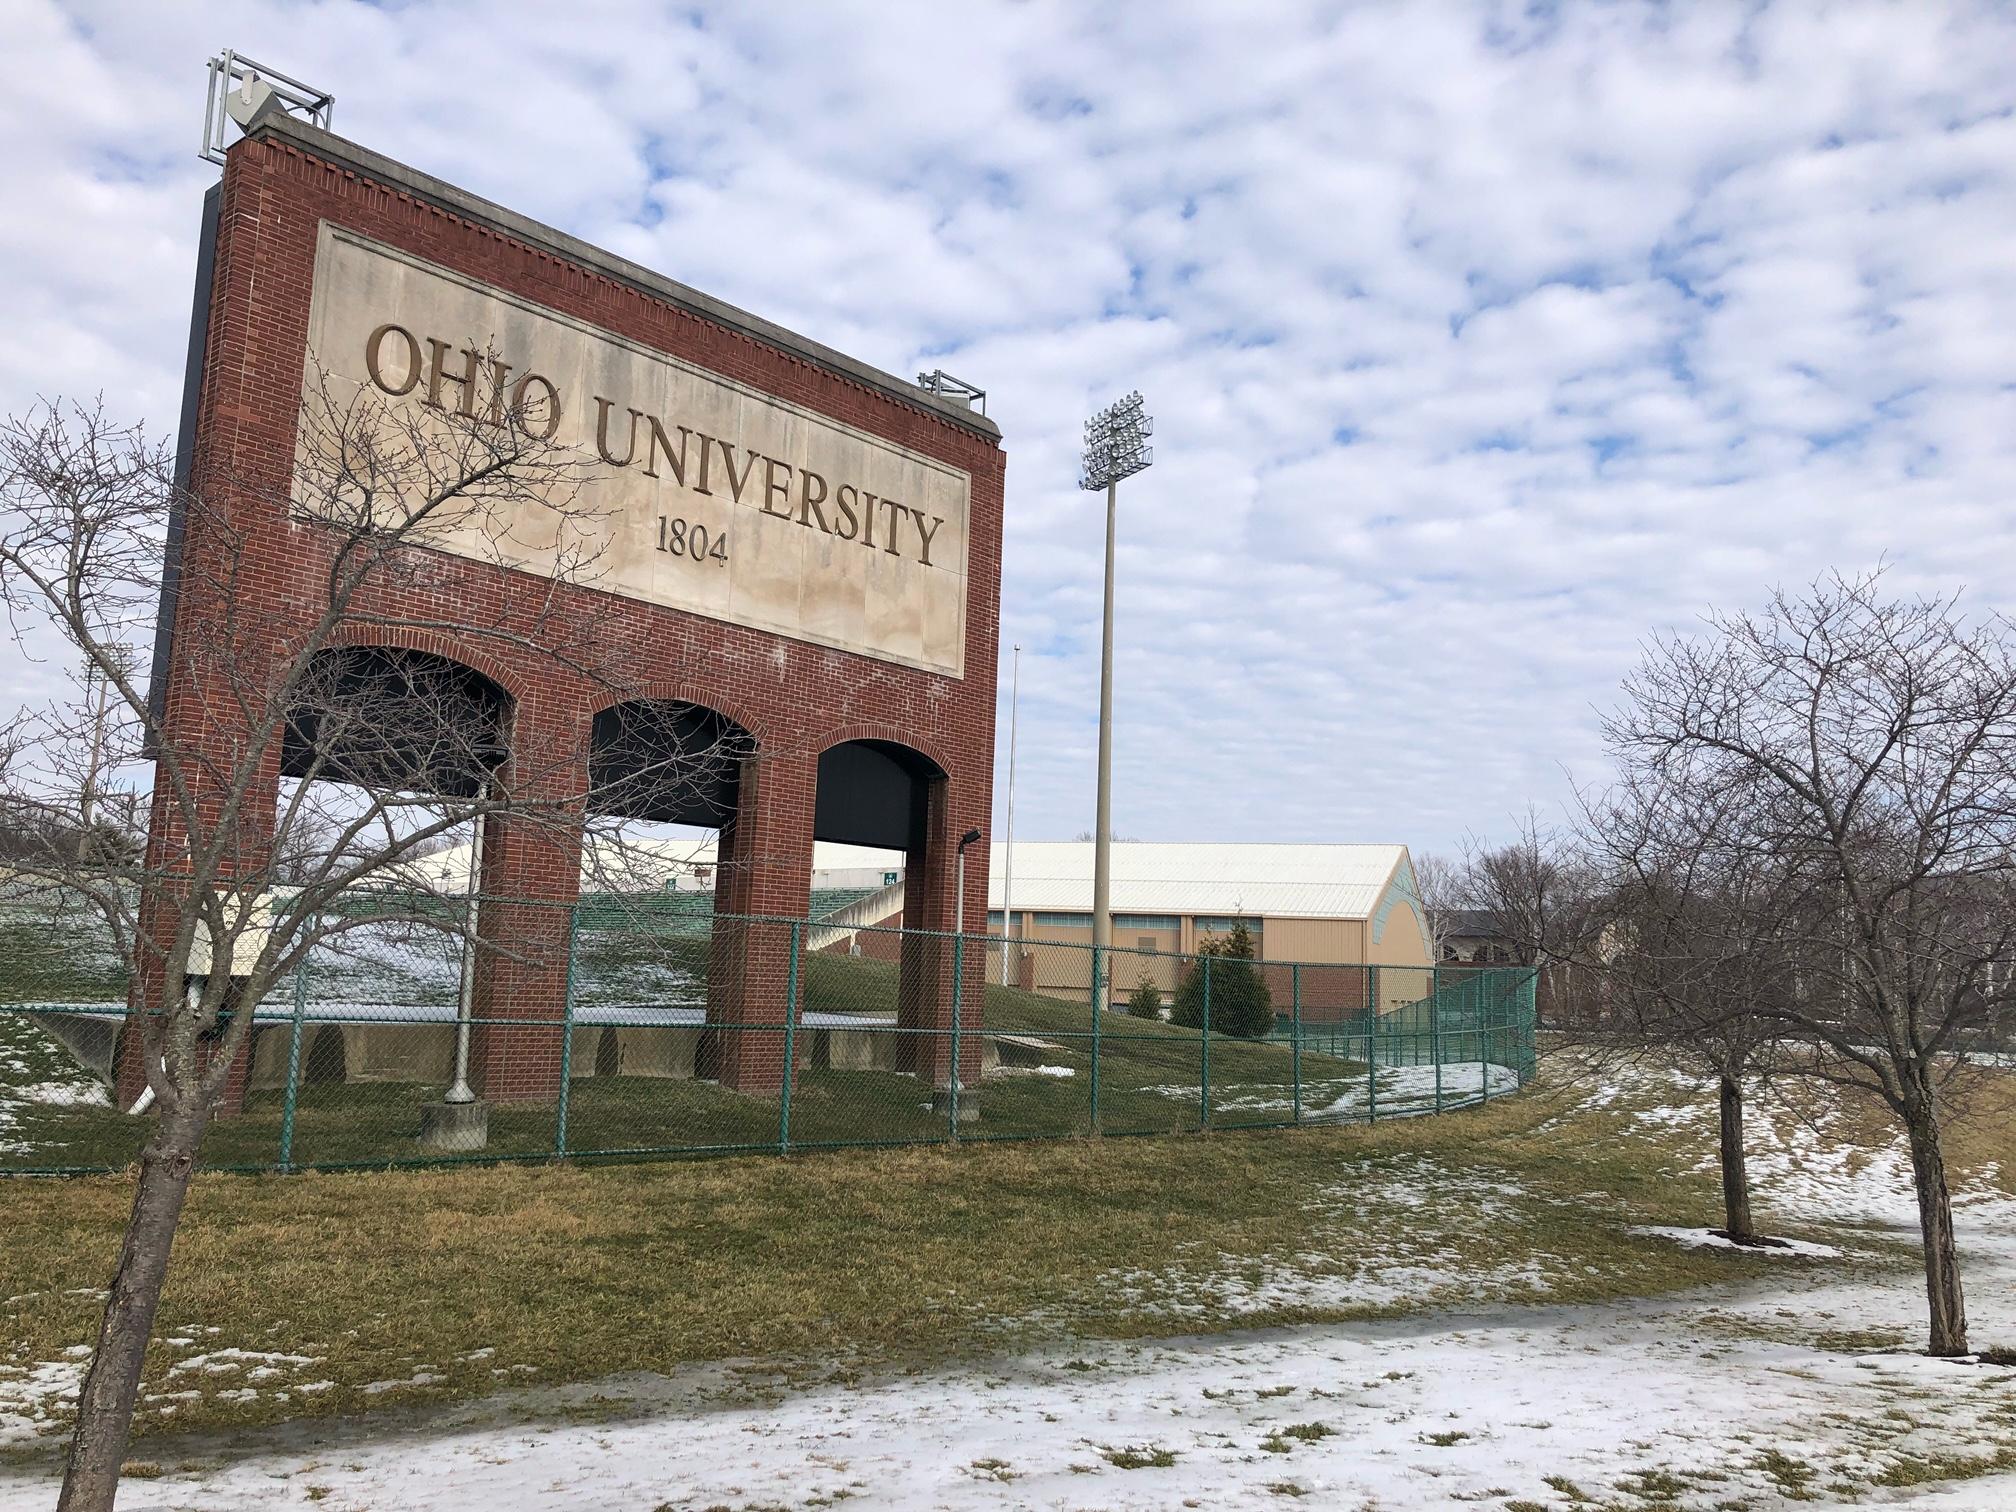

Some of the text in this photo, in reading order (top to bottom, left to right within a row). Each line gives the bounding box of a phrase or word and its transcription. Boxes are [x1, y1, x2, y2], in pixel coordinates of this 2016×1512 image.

[366, 323, 944, 566] OHIO UNIVERSITY
[656, 514, 728, 567] 1804
